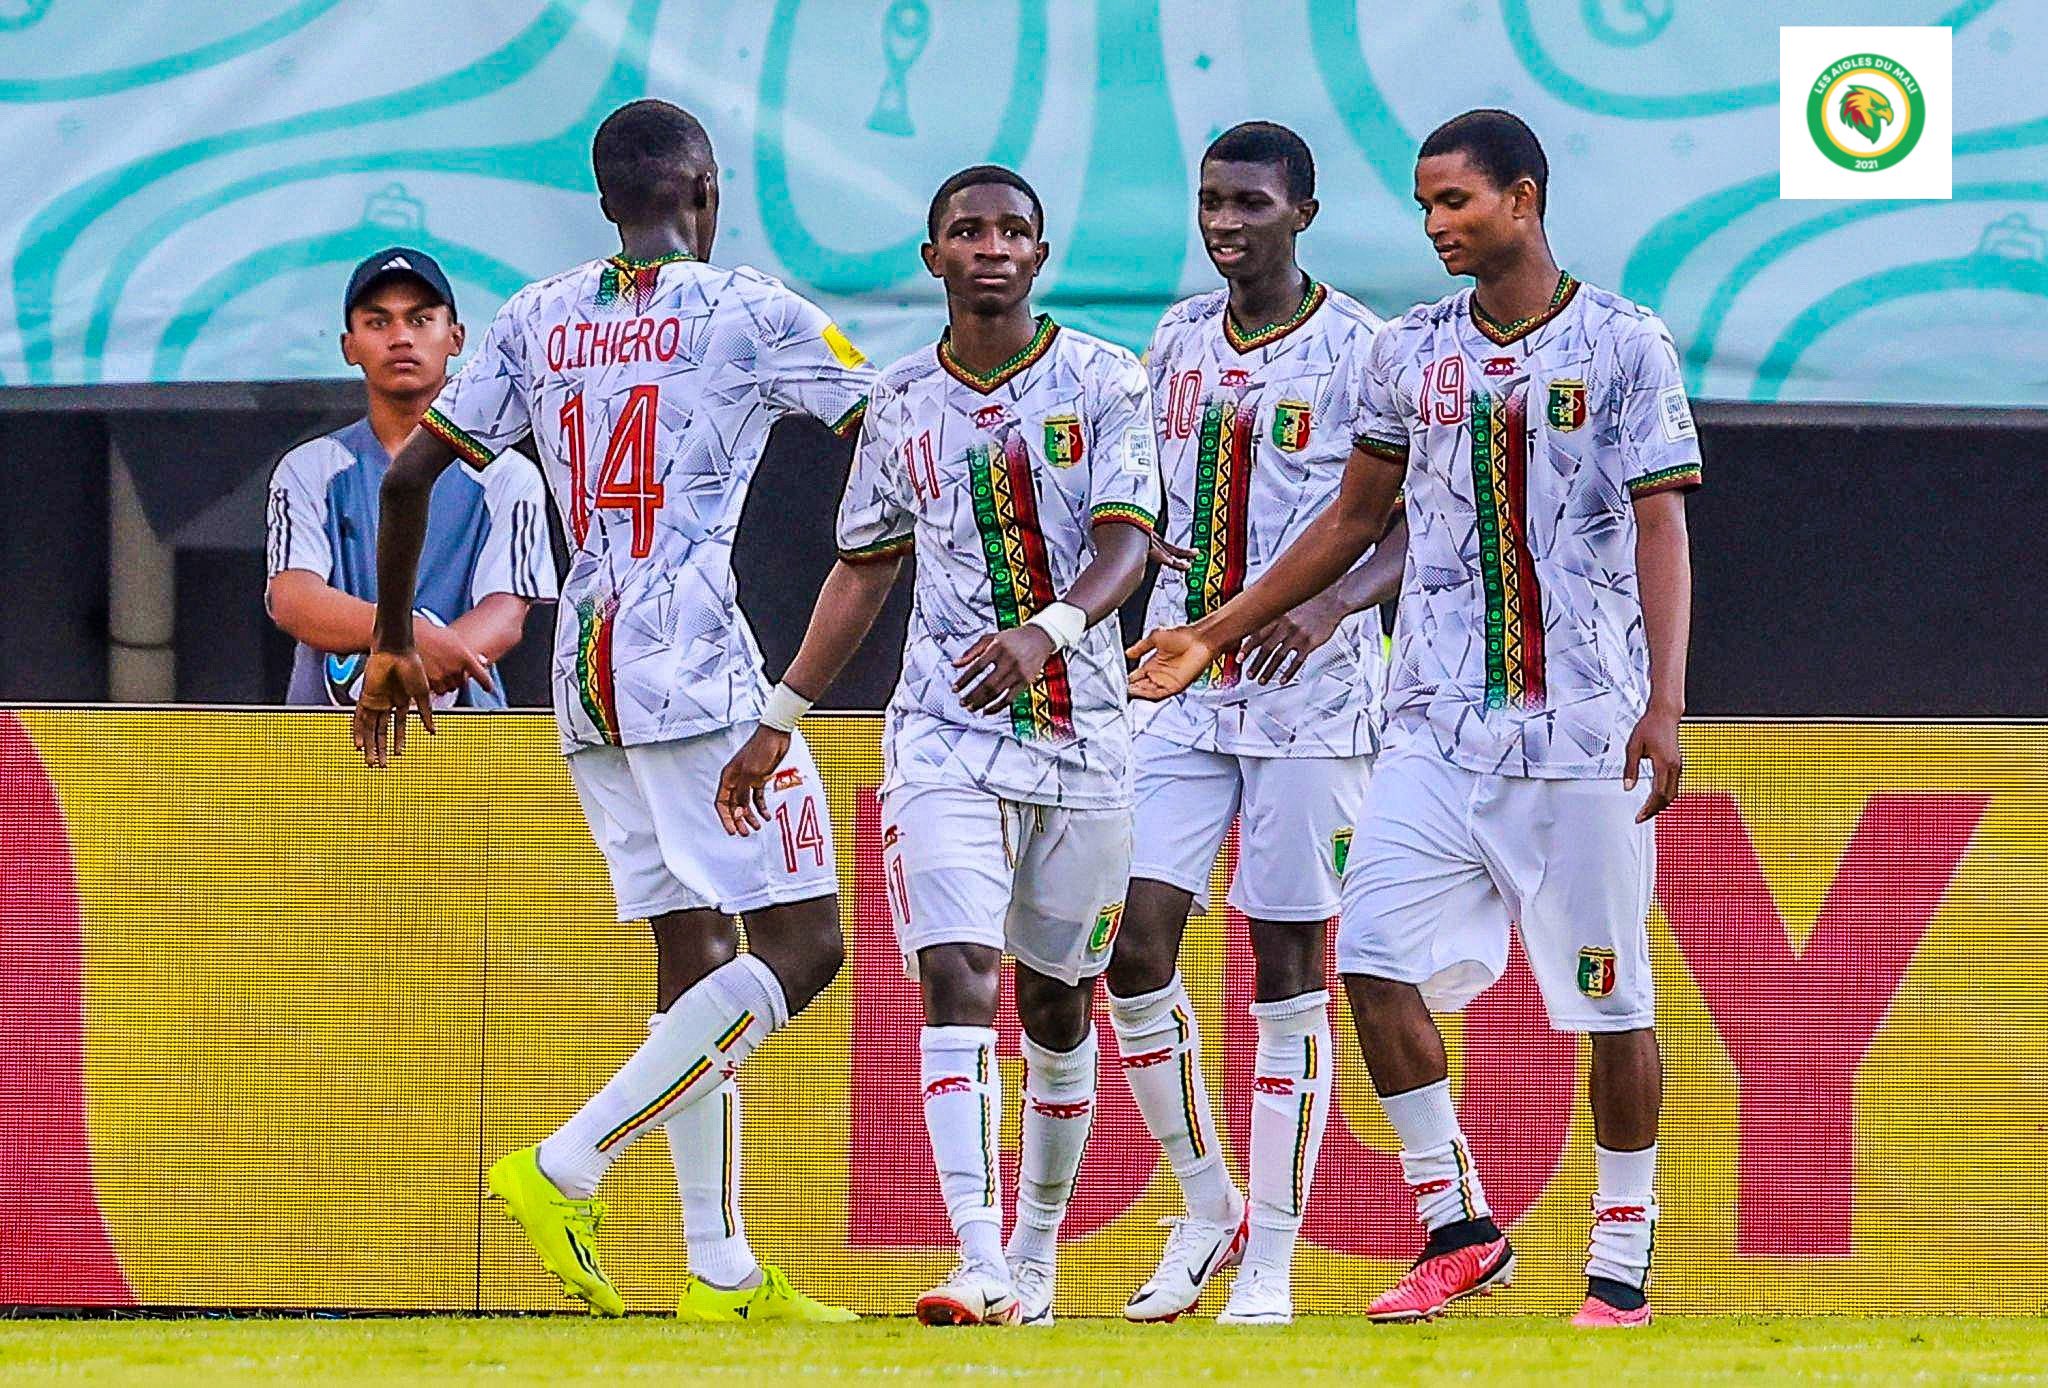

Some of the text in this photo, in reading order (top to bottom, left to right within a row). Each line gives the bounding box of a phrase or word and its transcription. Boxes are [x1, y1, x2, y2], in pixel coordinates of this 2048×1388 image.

[1165, 369, 1202, 440] 10
[1419, 355, 1465, 426] 19
[559, 384, 664, 559] 14
[904, 430, 941, 500] 11
[775, 795, 824, 874] 14
